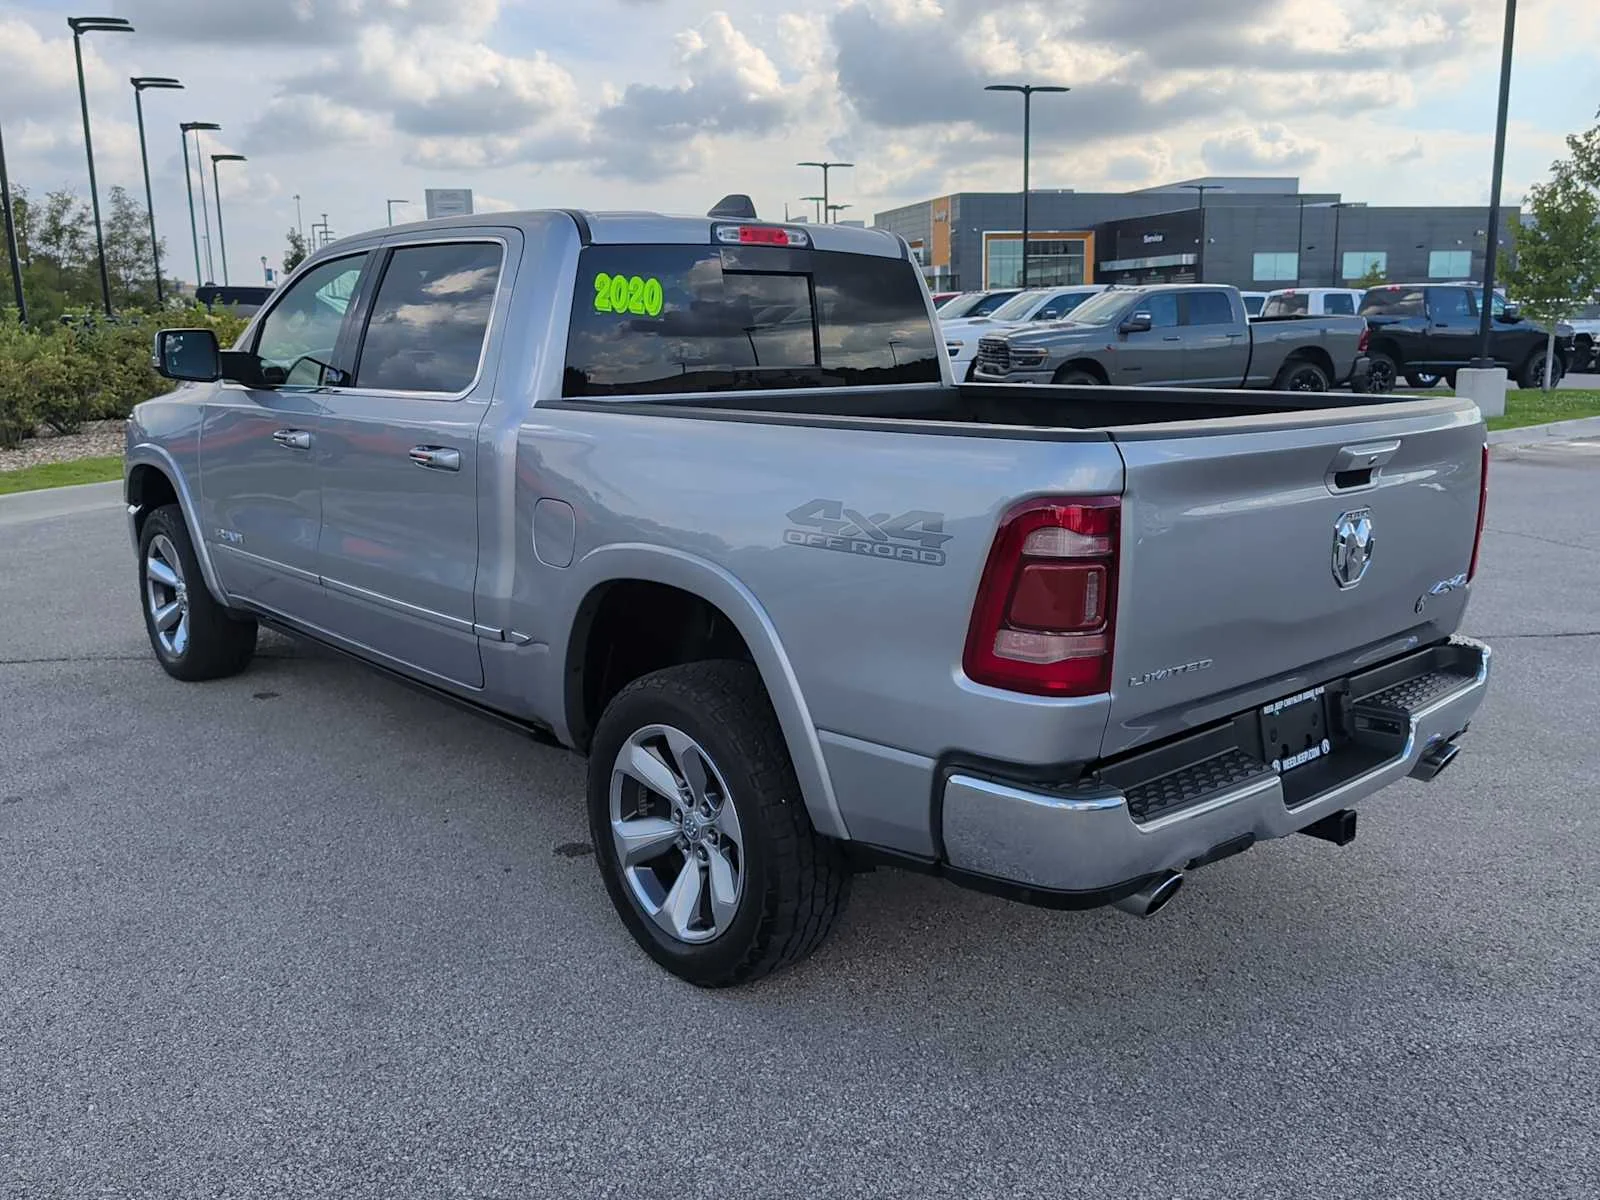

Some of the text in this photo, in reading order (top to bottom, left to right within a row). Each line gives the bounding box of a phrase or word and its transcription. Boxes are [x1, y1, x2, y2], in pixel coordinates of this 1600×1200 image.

[593, 272, 664, 317] 2020
[786, 531, 943, 565] OFF ROAD
[1128, 658, 1213, 687] LIMITED
